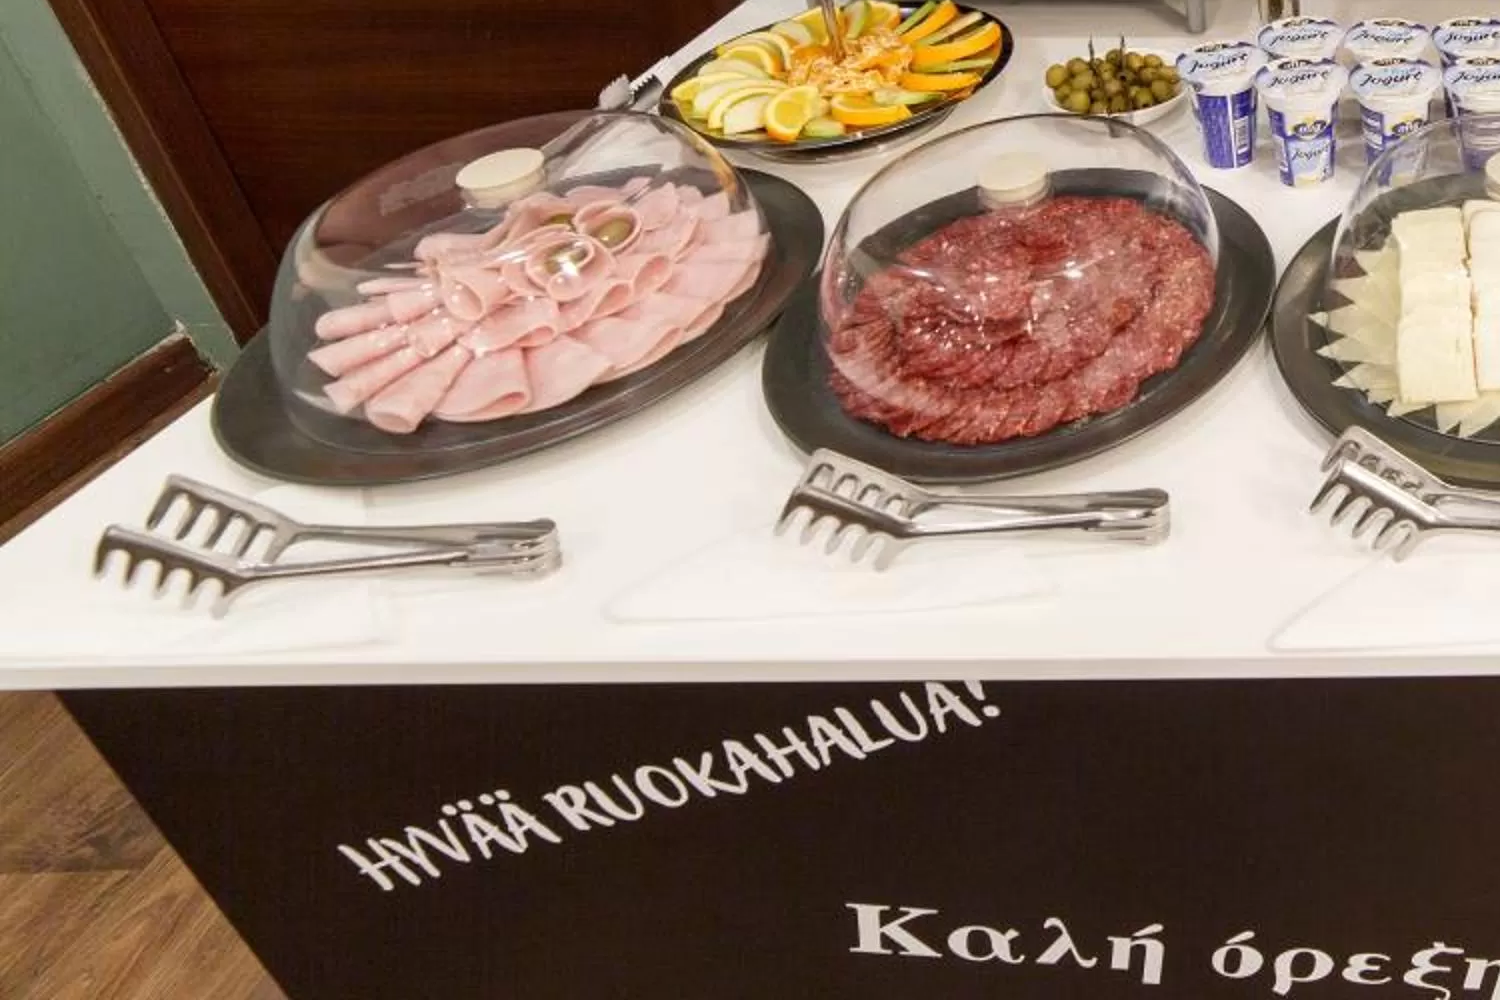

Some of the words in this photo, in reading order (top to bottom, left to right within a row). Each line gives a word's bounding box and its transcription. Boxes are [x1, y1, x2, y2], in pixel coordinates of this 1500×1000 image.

[1360, 70, 1423, 87] Jogurt
[338, 789, 562, 891] HYVÄÄ
[544, 679, 1000, 830] RUOKAHALUA!
[845, 903, 1165, 985] Καλή
